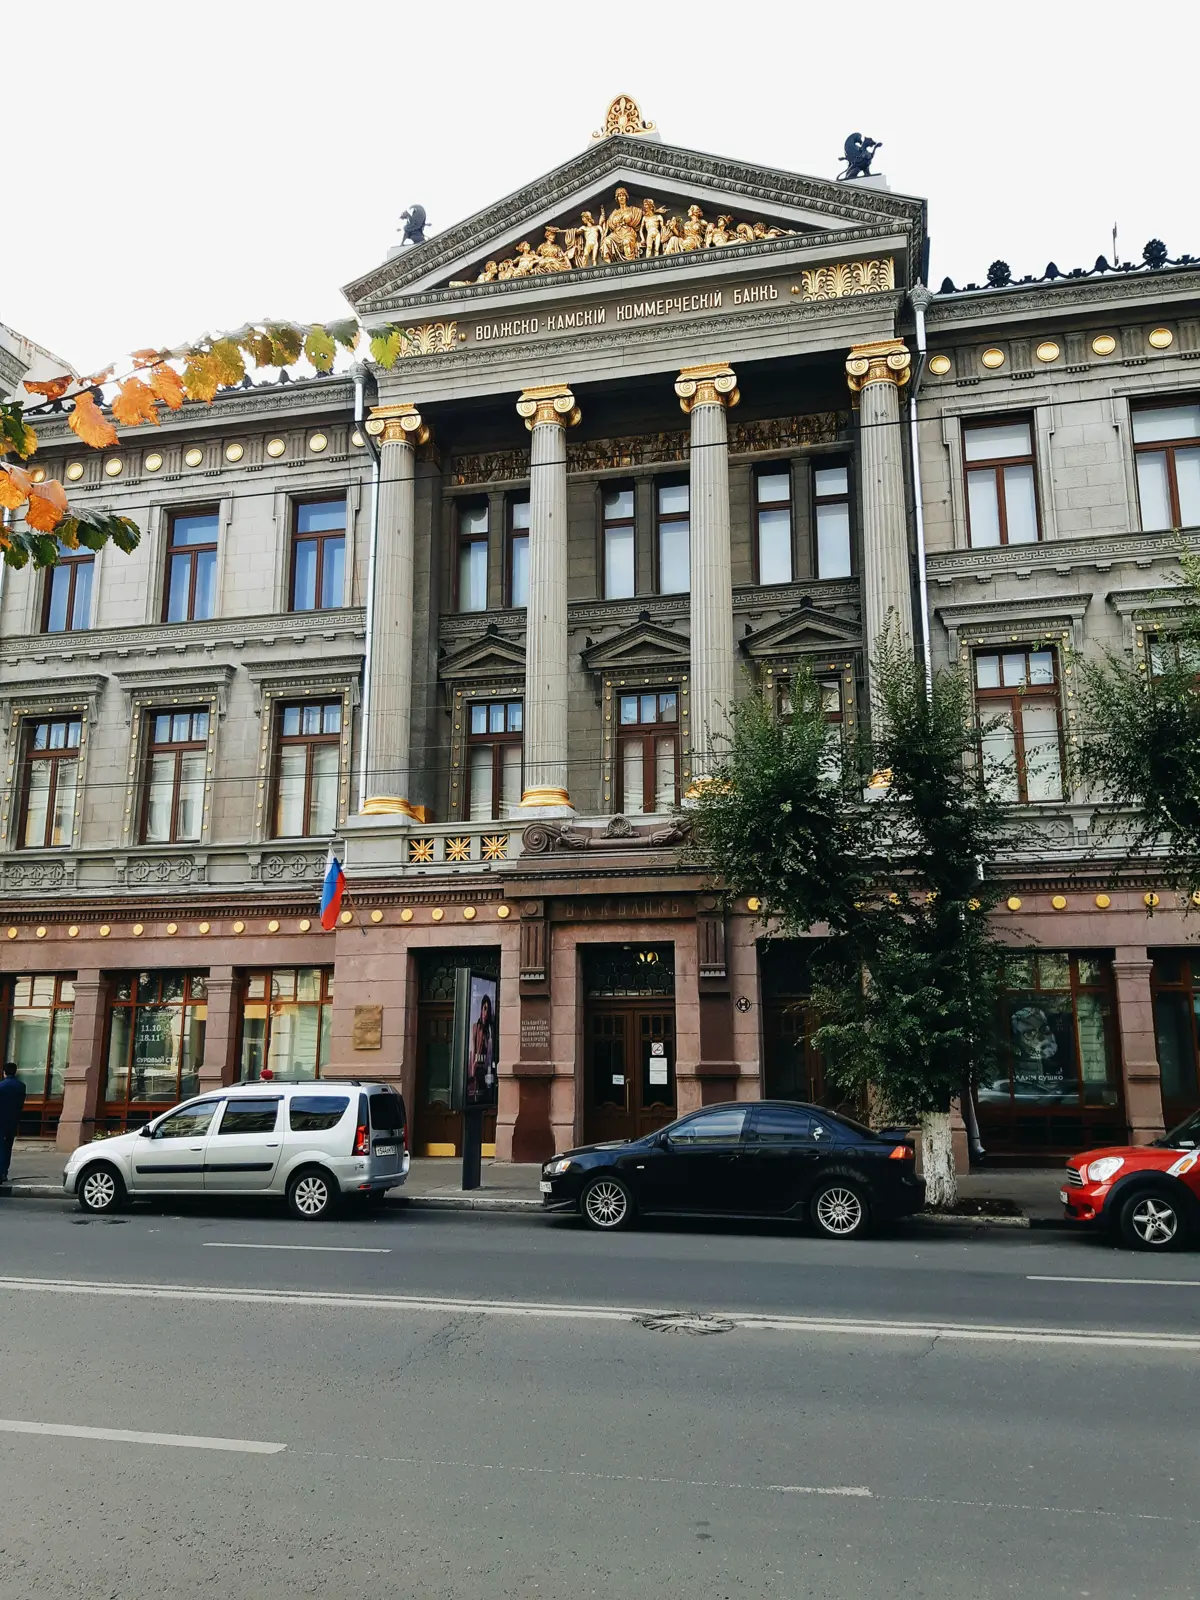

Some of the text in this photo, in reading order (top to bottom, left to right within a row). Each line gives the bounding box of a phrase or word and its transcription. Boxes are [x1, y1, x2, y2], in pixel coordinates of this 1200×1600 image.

[616, 289, 722, 321] КОММЕРЧЕСКІЙ
[733, 284, 778, 305] БАНКЪ
[140, 1024, 161, 1032] 11.10
[140, 1034, 160, 1042] 18.11
